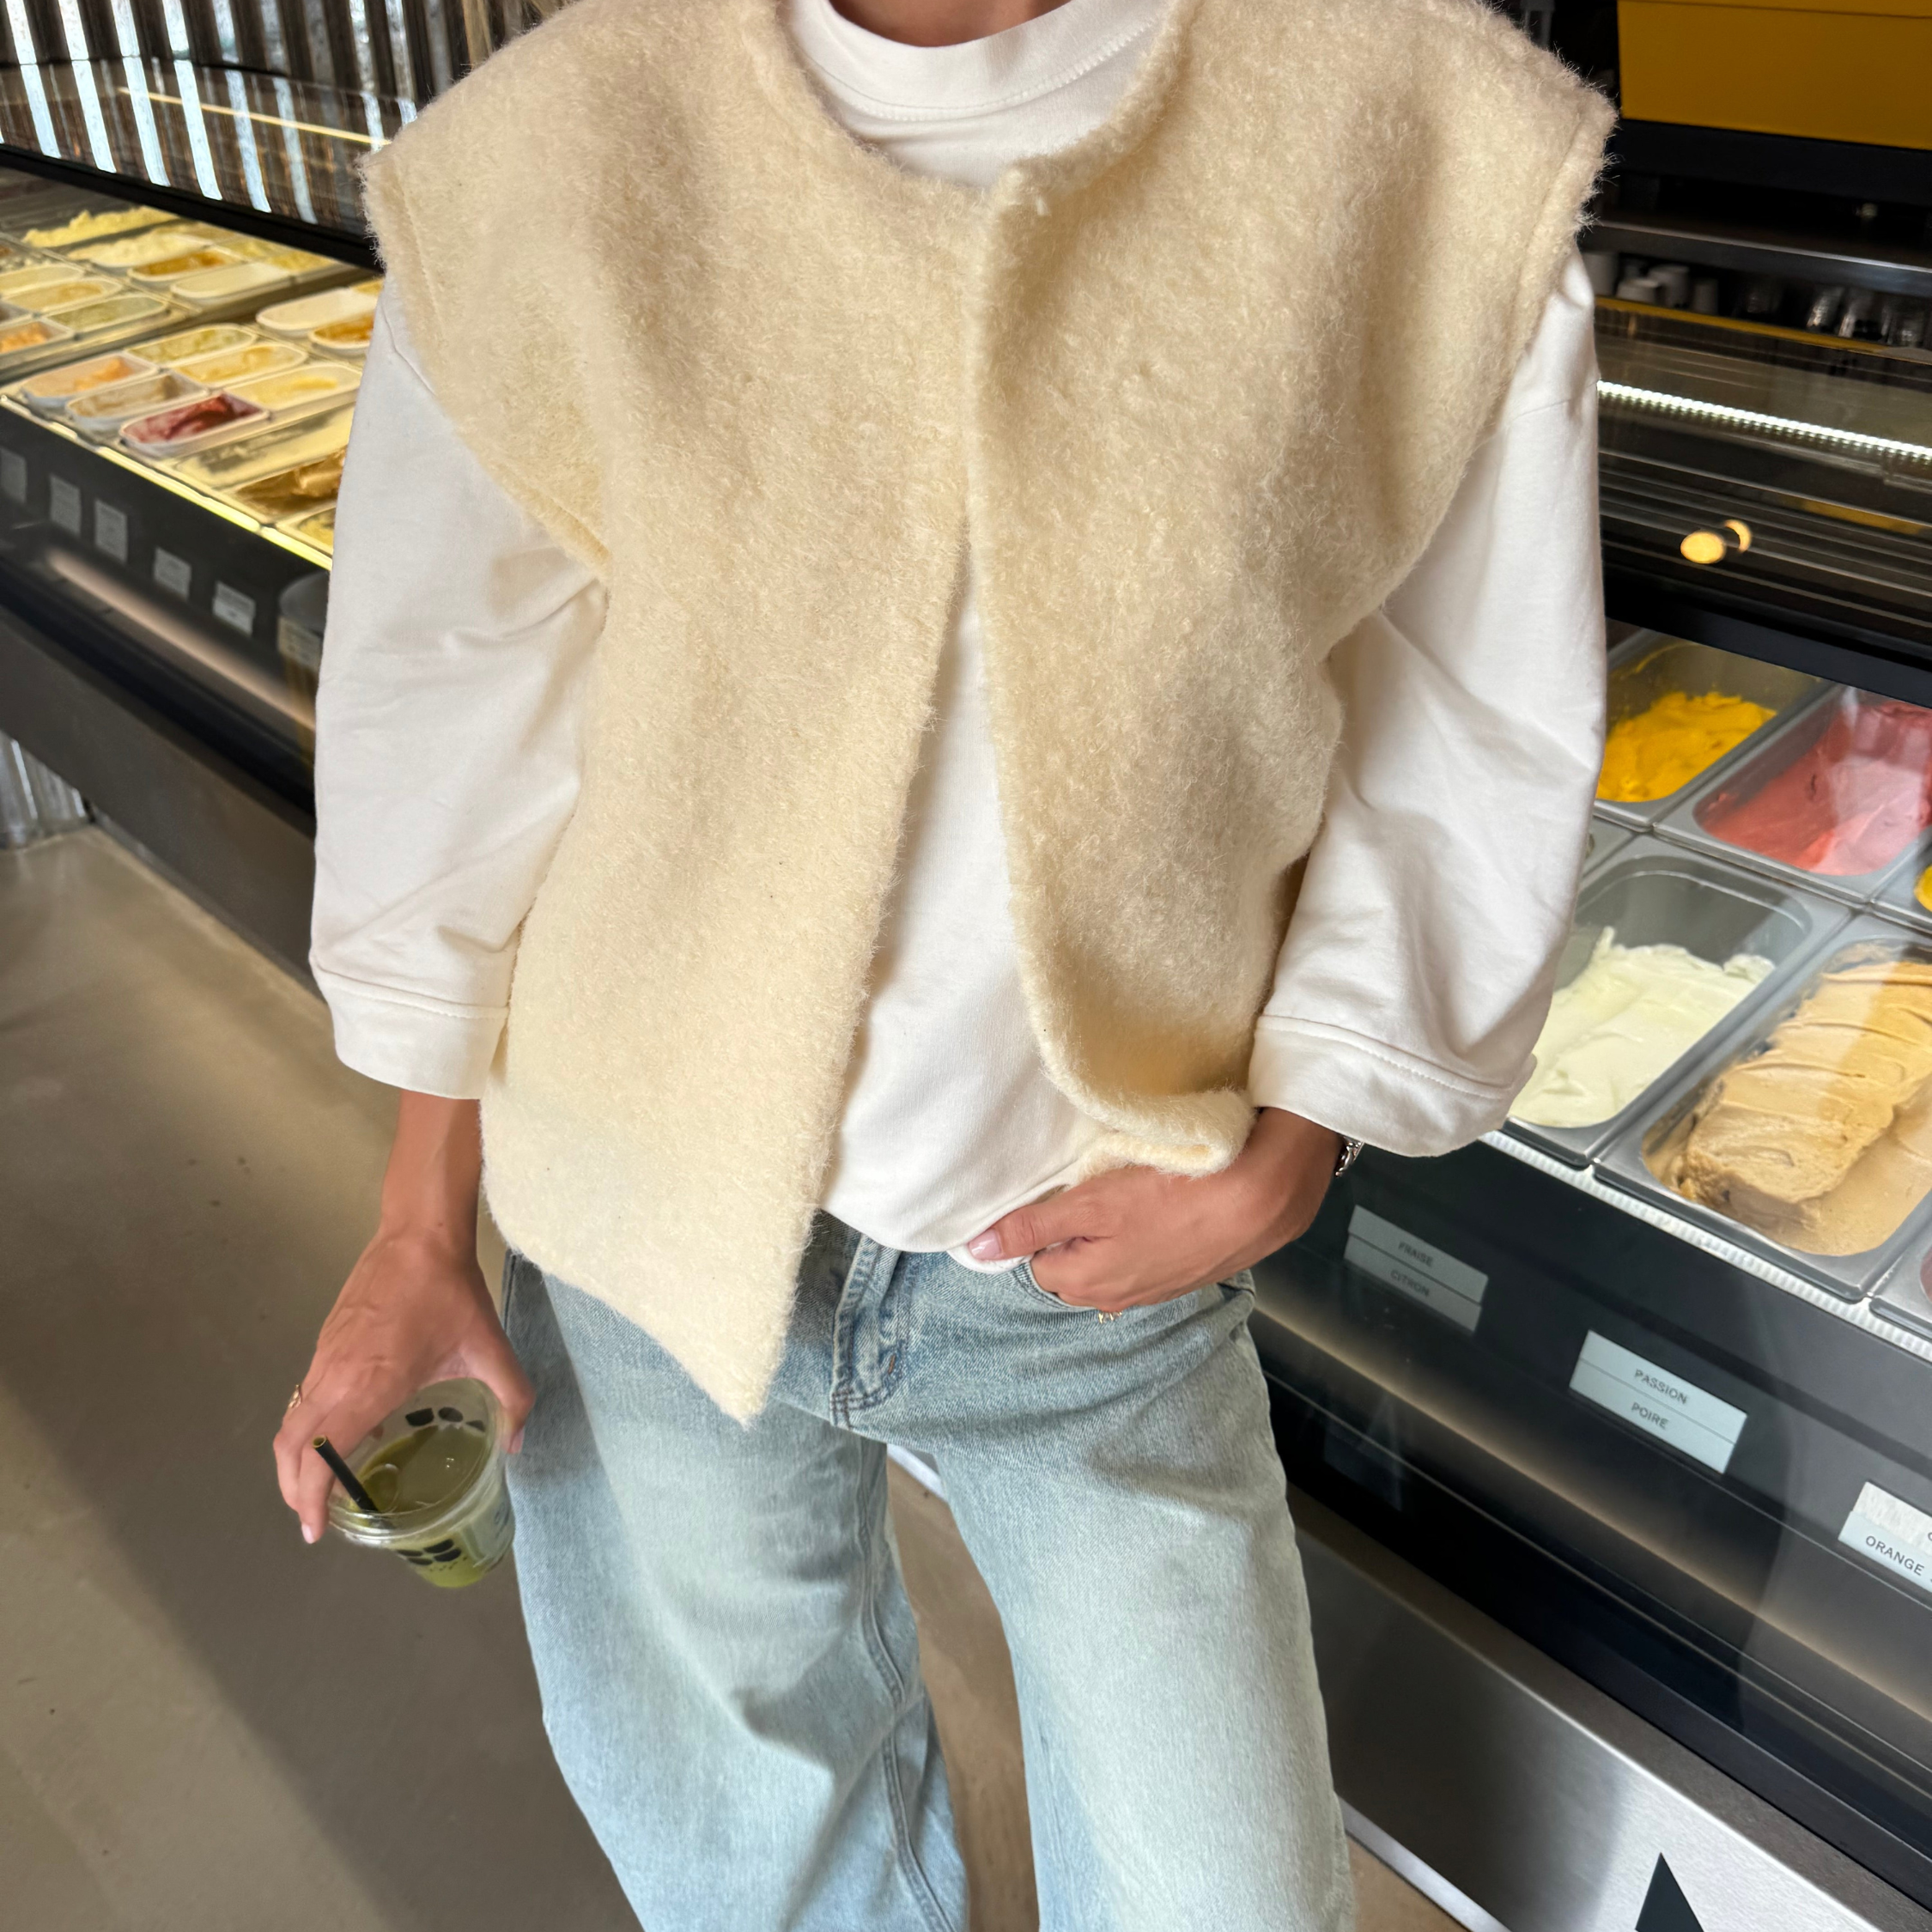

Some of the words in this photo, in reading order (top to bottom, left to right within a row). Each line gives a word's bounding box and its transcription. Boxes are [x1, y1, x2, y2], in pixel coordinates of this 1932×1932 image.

[1398, 1242, 1433, 1267] FRAISE
[1389, 1269, 1430, 1297] CITRON
[1634, 1369, 1688, 1405] PASSION
[1631, 1402, 1669, 1430] POIRE
[1866, 1535, 1925, 1576] ORANGE
